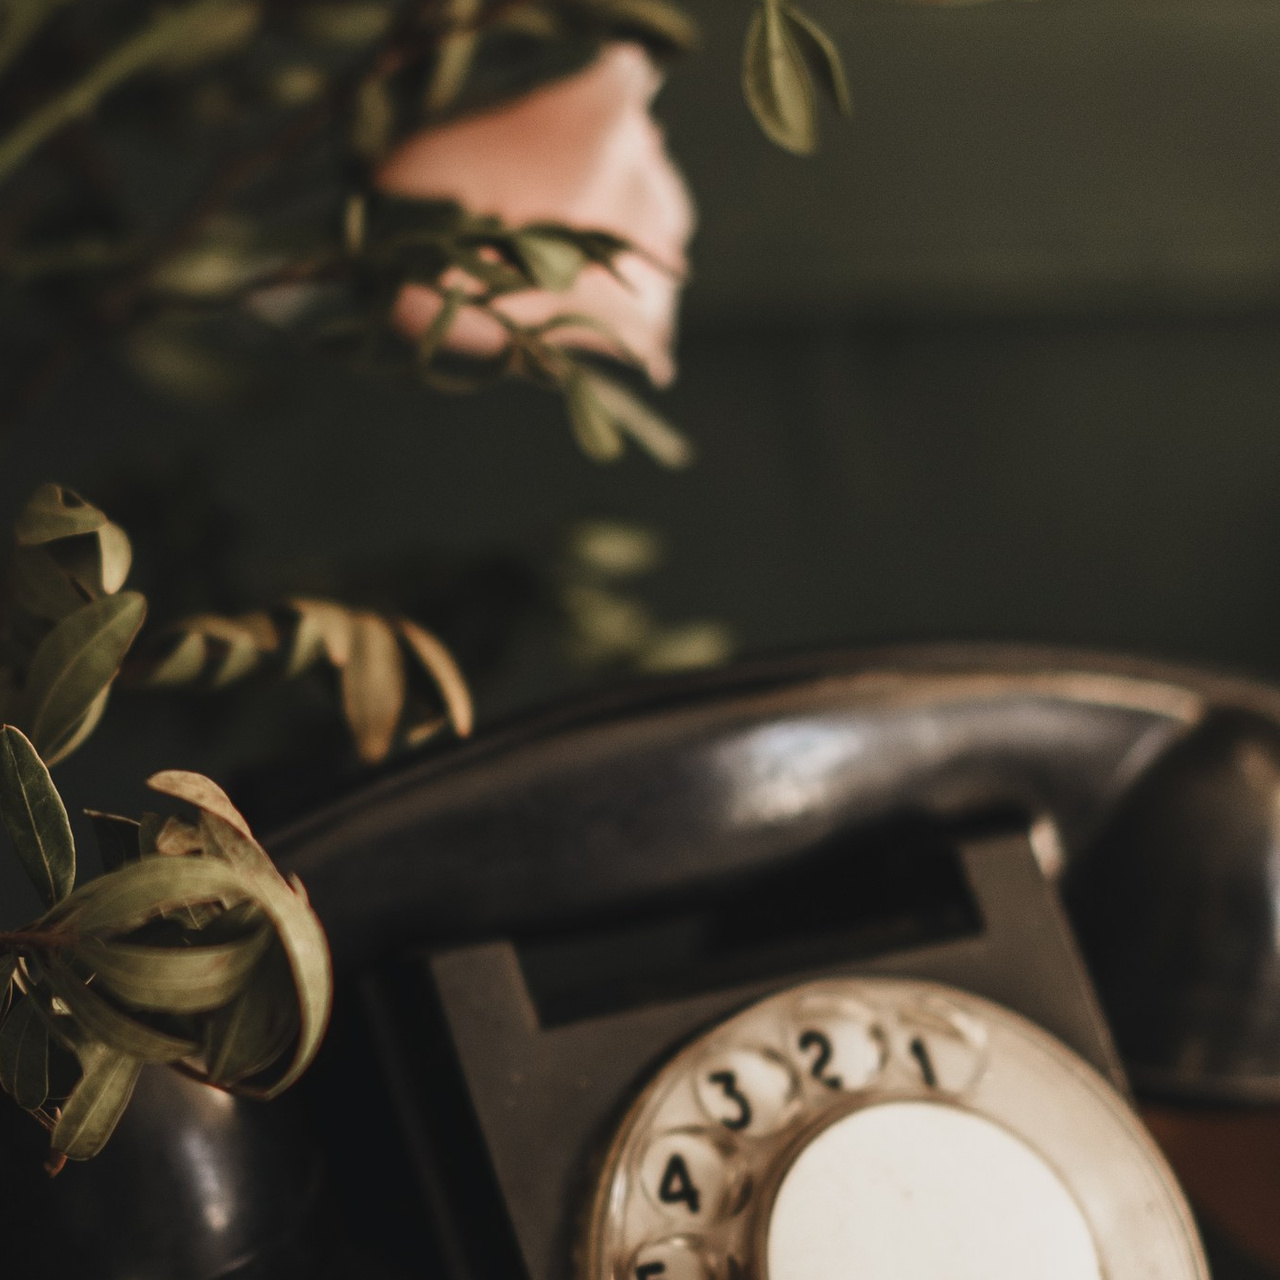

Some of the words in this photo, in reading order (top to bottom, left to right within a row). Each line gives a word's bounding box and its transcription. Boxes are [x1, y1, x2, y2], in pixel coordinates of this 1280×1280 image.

[798, 1030, 841, 1091] 2
[910, 1037, 936, 1088] 1
[709, 1070, 752, 1131] 3
[658, 1153, 701, 1214] 4
